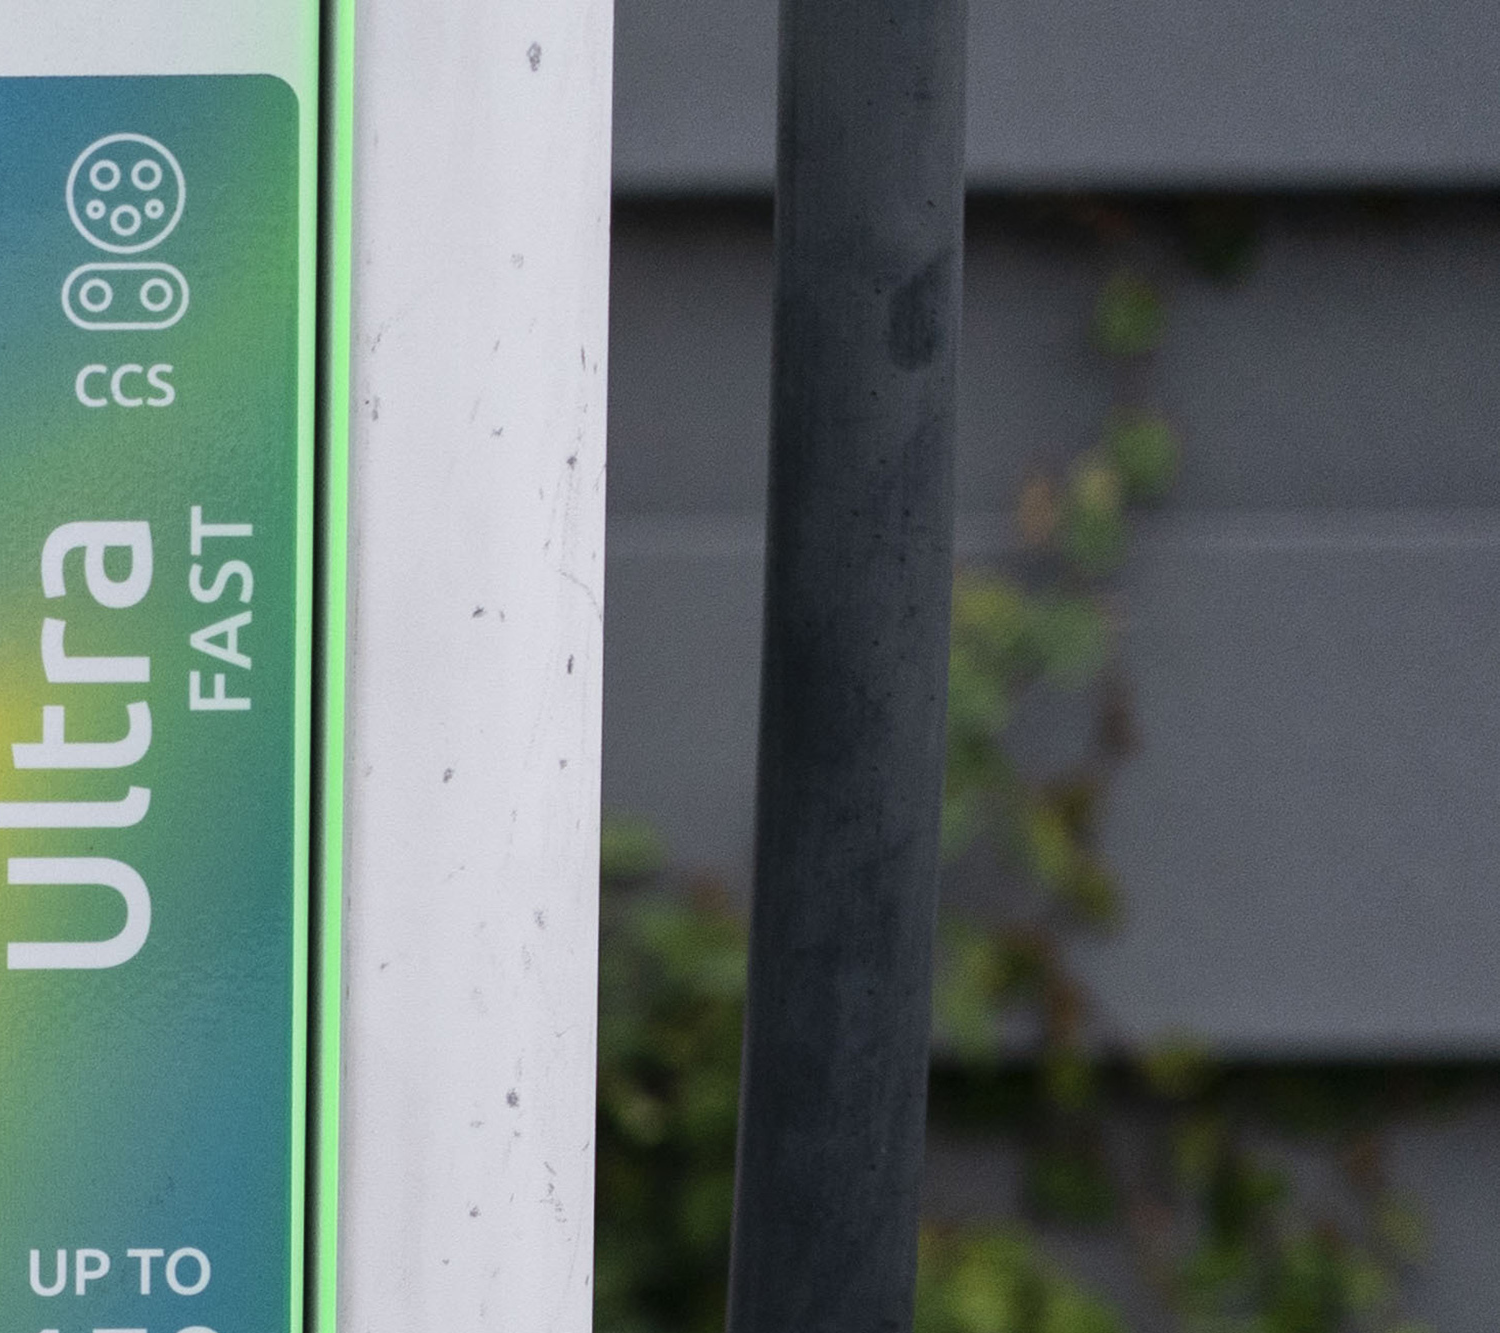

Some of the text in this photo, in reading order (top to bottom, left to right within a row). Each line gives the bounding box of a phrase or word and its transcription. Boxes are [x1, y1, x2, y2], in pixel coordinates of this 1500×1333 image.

[75, 363, 176, 408] CCS
[188, 505, 254, 711] FAST
[29, 1247, 211, 1297] UP TO
